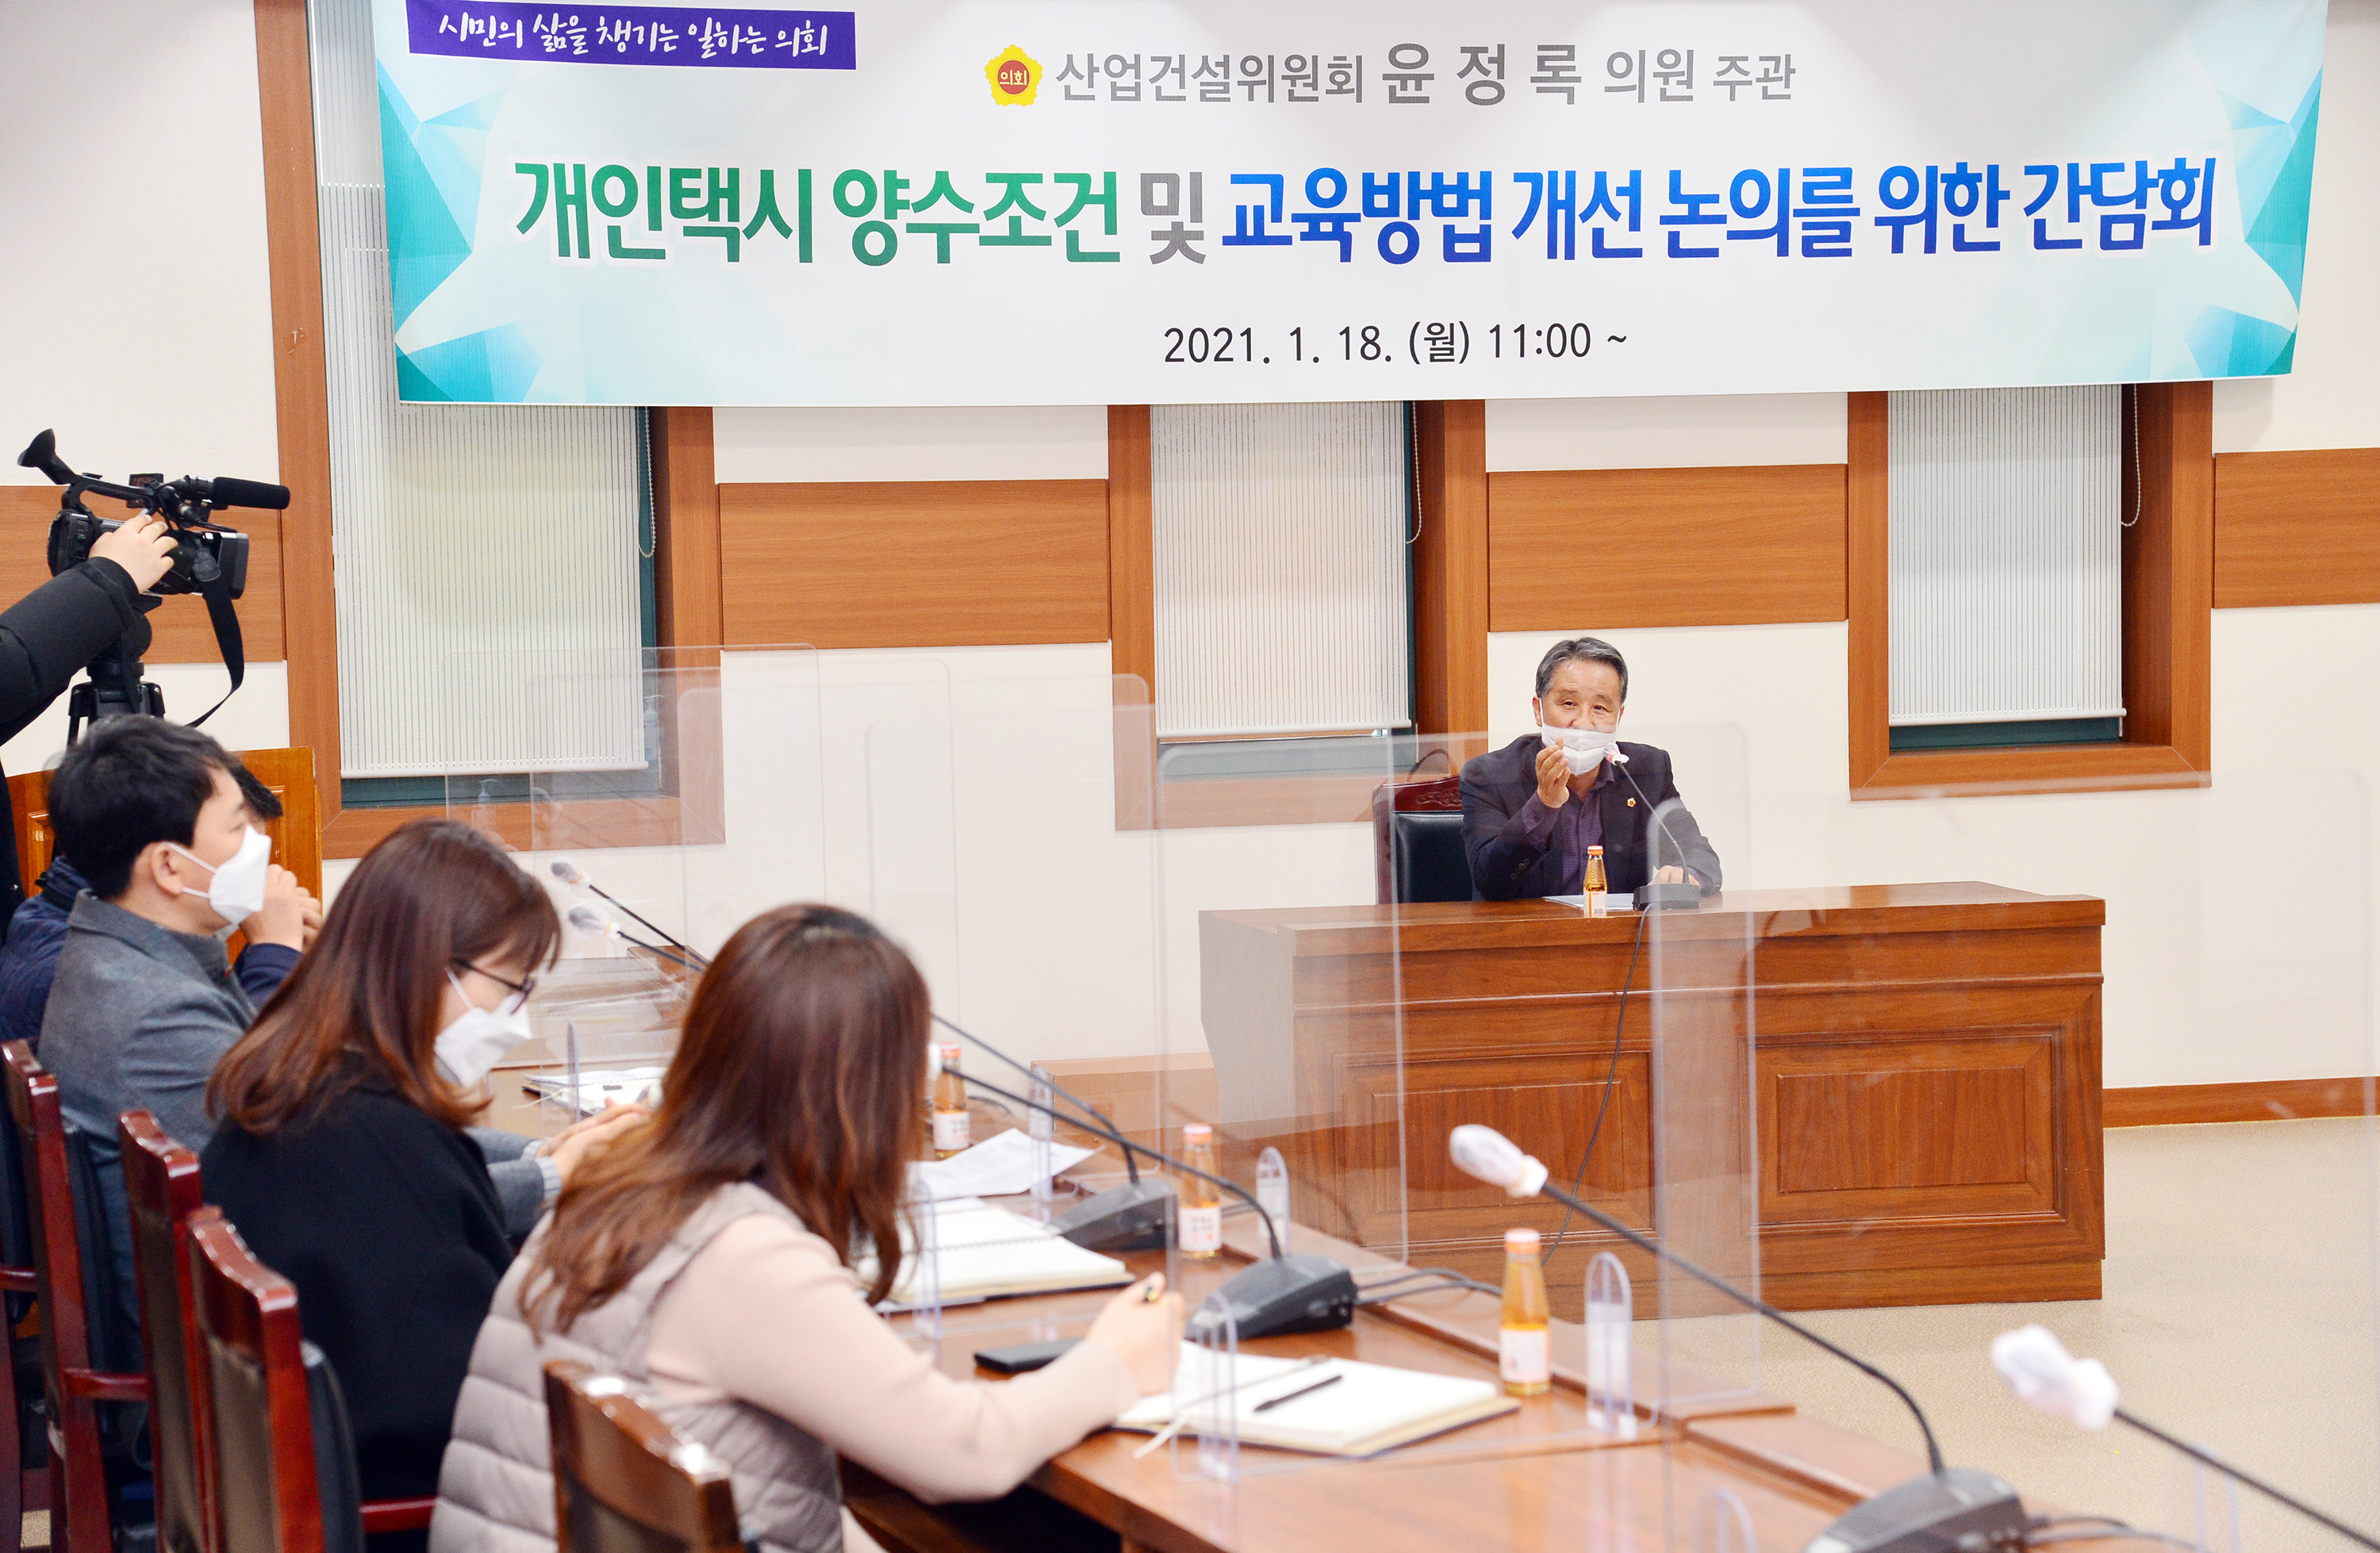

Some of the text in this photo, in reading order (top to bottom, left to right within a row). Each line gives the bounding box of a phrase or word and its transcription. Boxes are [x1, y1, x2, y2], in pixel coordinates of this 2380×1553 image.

[440, 12, 827, 59] 시민의 삶을 챙기는 일하는 의회
[1000, 70, 1027, 86] 의회
[1056, 54, 1362, 102] 산업건설위원회
[1603, 49, 1695, 103] 의원
[1712, 55, 1796, 101] 주관
[515, 158, 2216, 267] 개인택시 양수조건 및 교육방법 개선 논의를 위한 간담회
[1165, 328, 1269, 363] 2021.
[1290, 328, 1319, 362] 1.
[1339, 326, 1391, 362] 18.
[1410, 321, 1468, 364] (월)
[1490, 323, 1590, 358] 11:00
